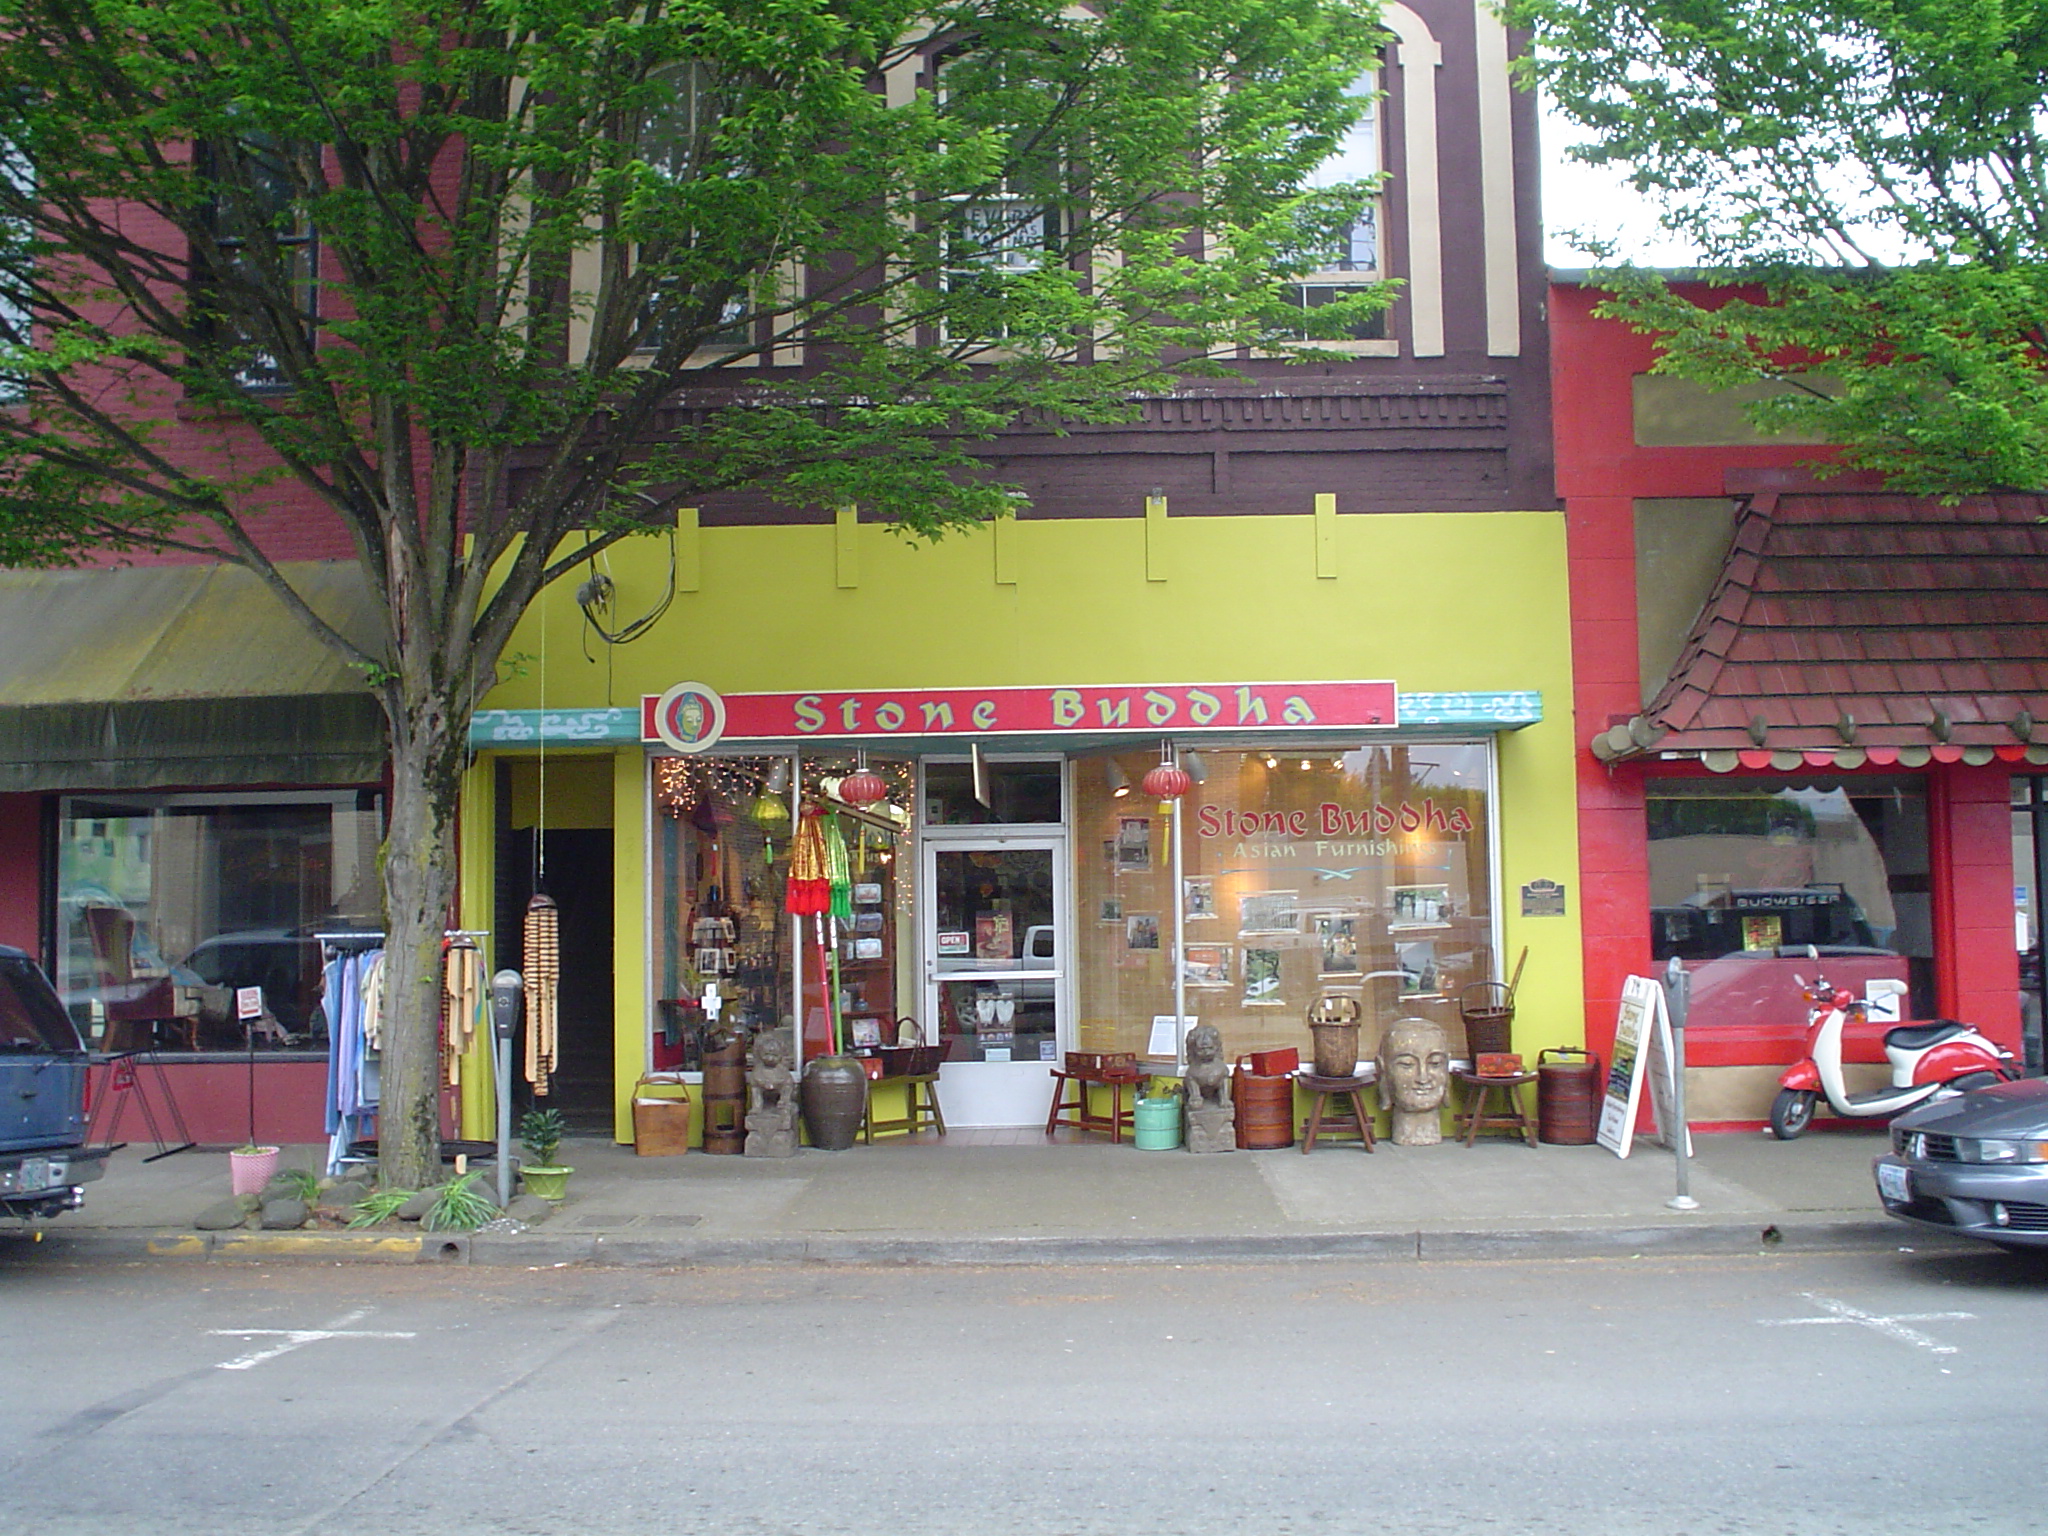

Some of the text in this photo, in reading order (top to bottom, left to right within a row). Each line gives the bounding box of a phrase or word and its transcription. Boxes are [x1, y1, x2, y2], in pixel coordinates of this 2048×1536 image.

[793, 685, 1318, 733] Stone Buddha
[1198, 797, 1474, 838] Stone Buddha
[1232, 841, 1297, 859] Asian
[1736, 894, 1841, 908] BUDWEISER
